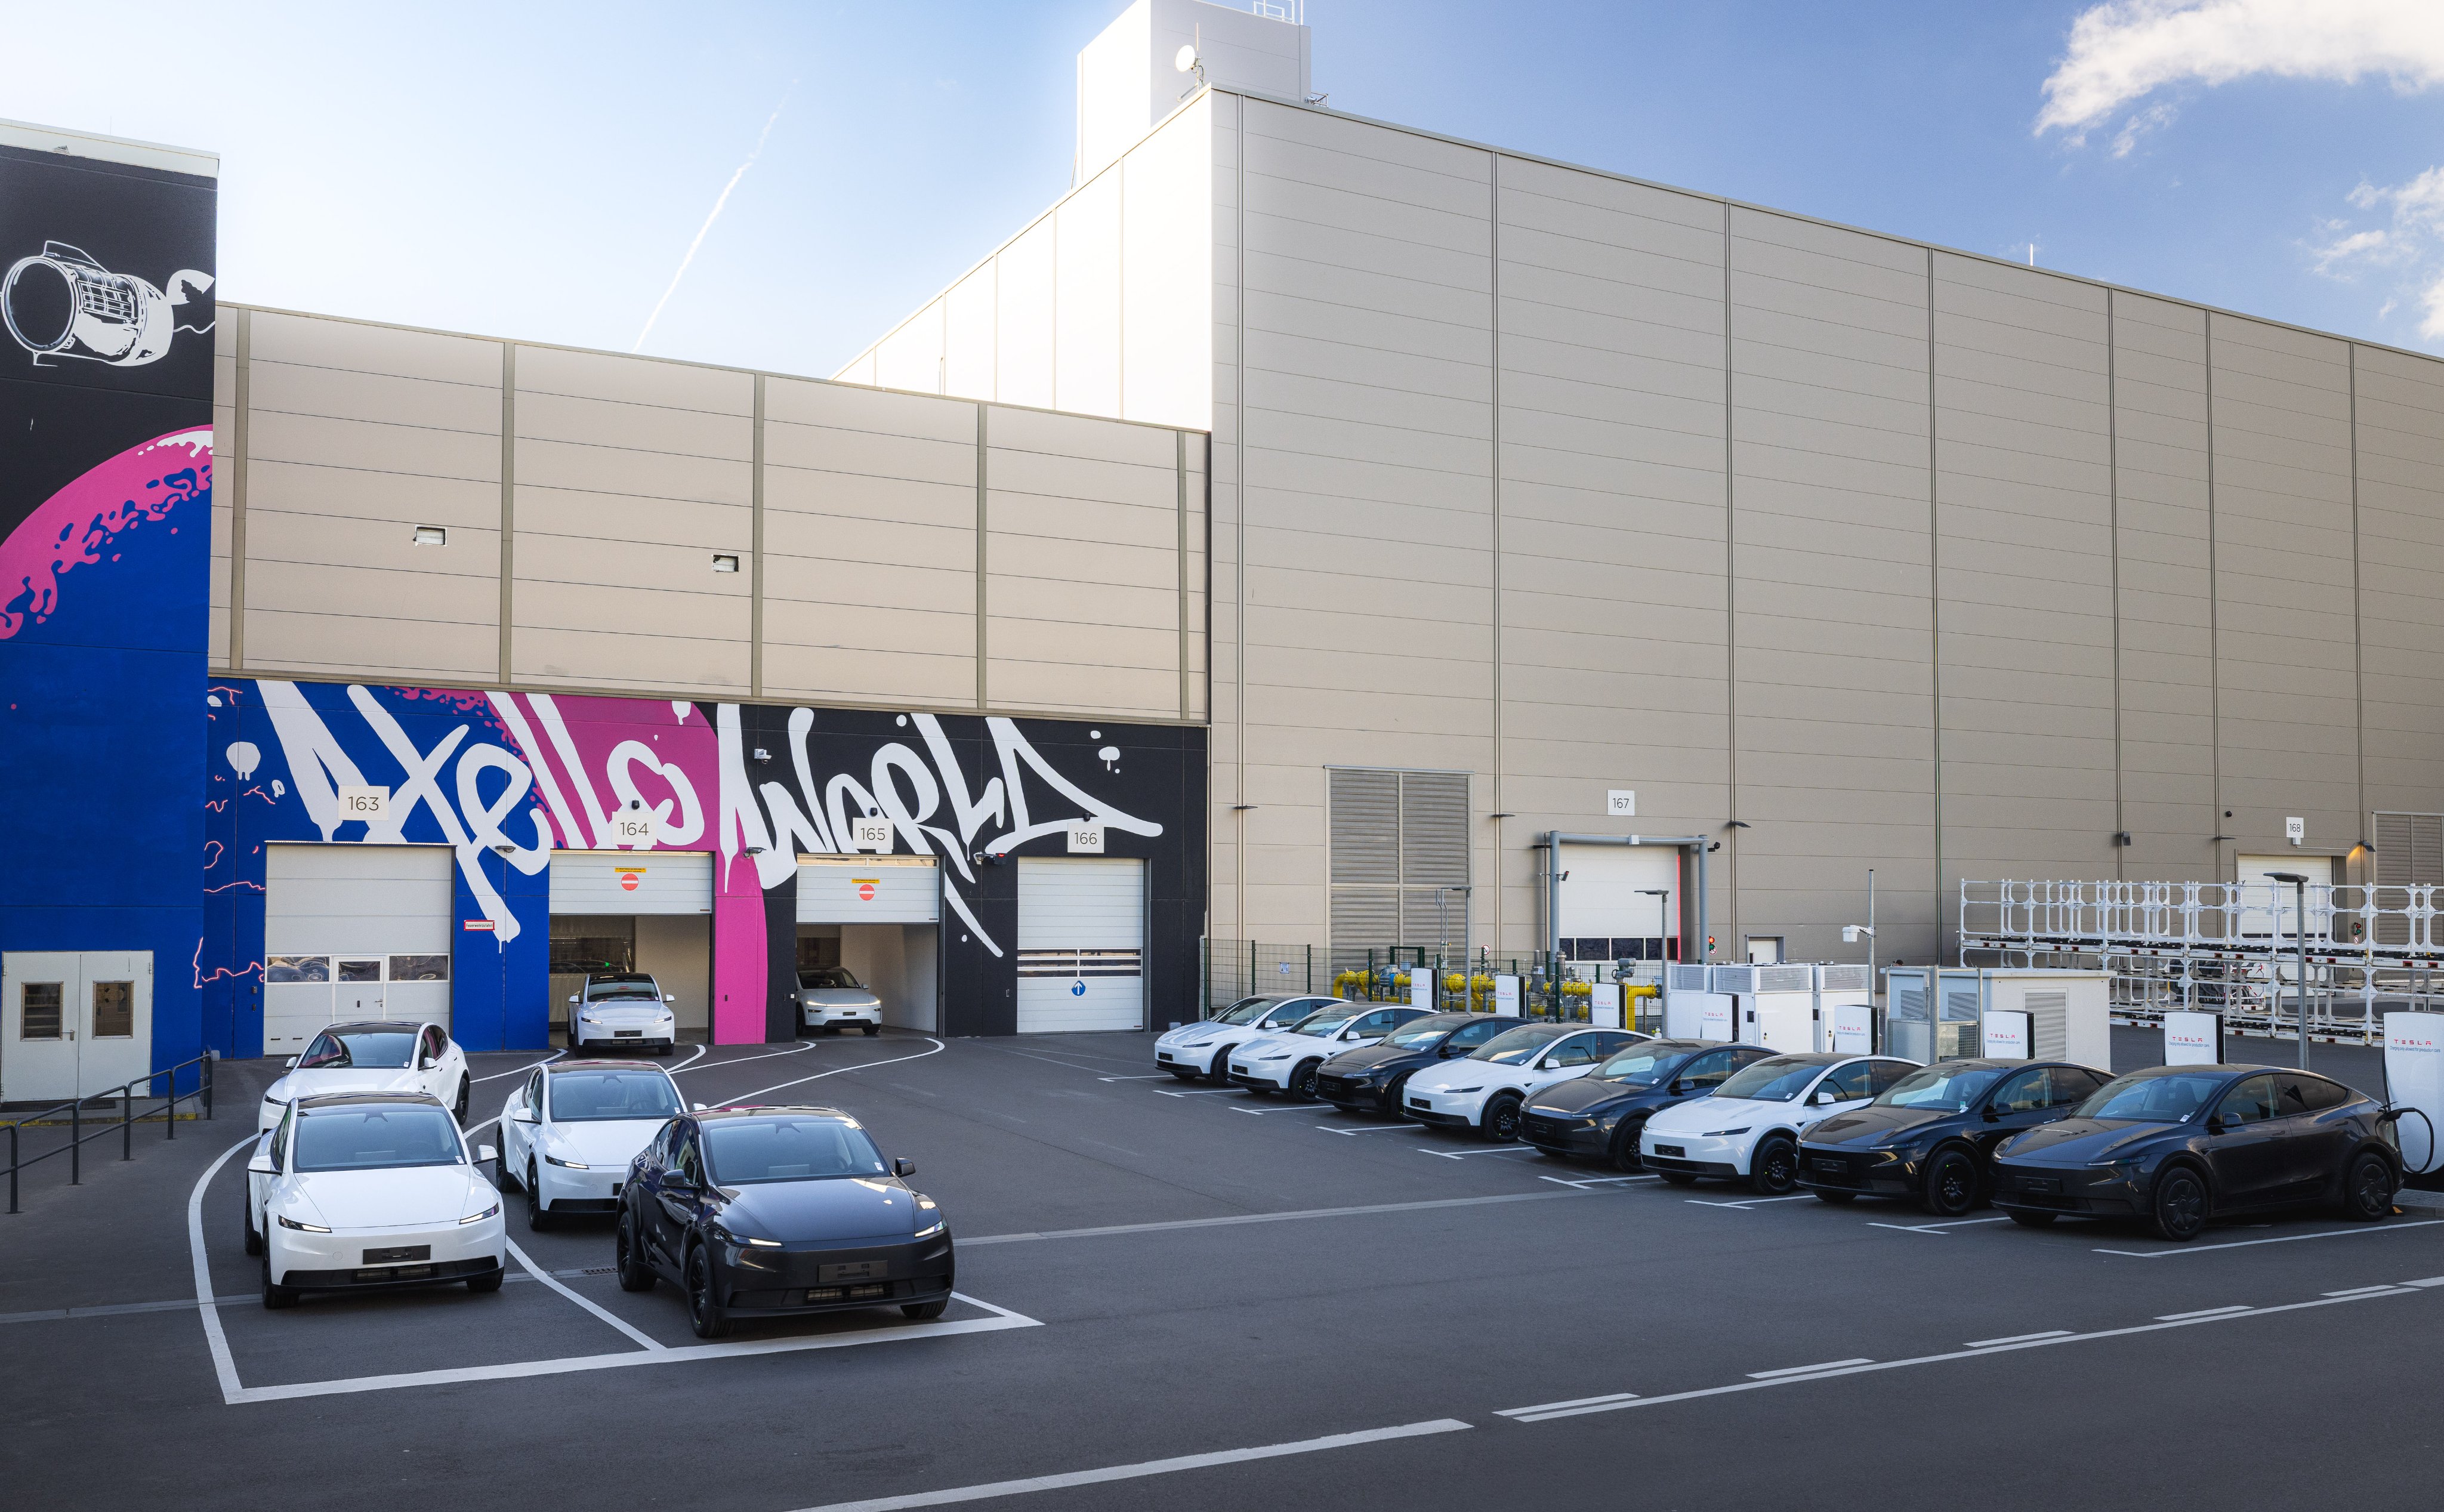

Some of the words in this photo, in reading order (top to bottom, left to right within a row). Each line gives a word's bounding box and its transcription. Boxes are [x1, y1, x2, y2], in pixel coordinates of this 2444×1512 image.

[348, 796, 379, 811] 163
[1613, 798, 1630, 809] 167
[620, 822, 649, 836] 164
[2289, 823, 2301, 832] 168
[860, 828, 885, 841] 165
[1074, 832, 1097, 844] 166
